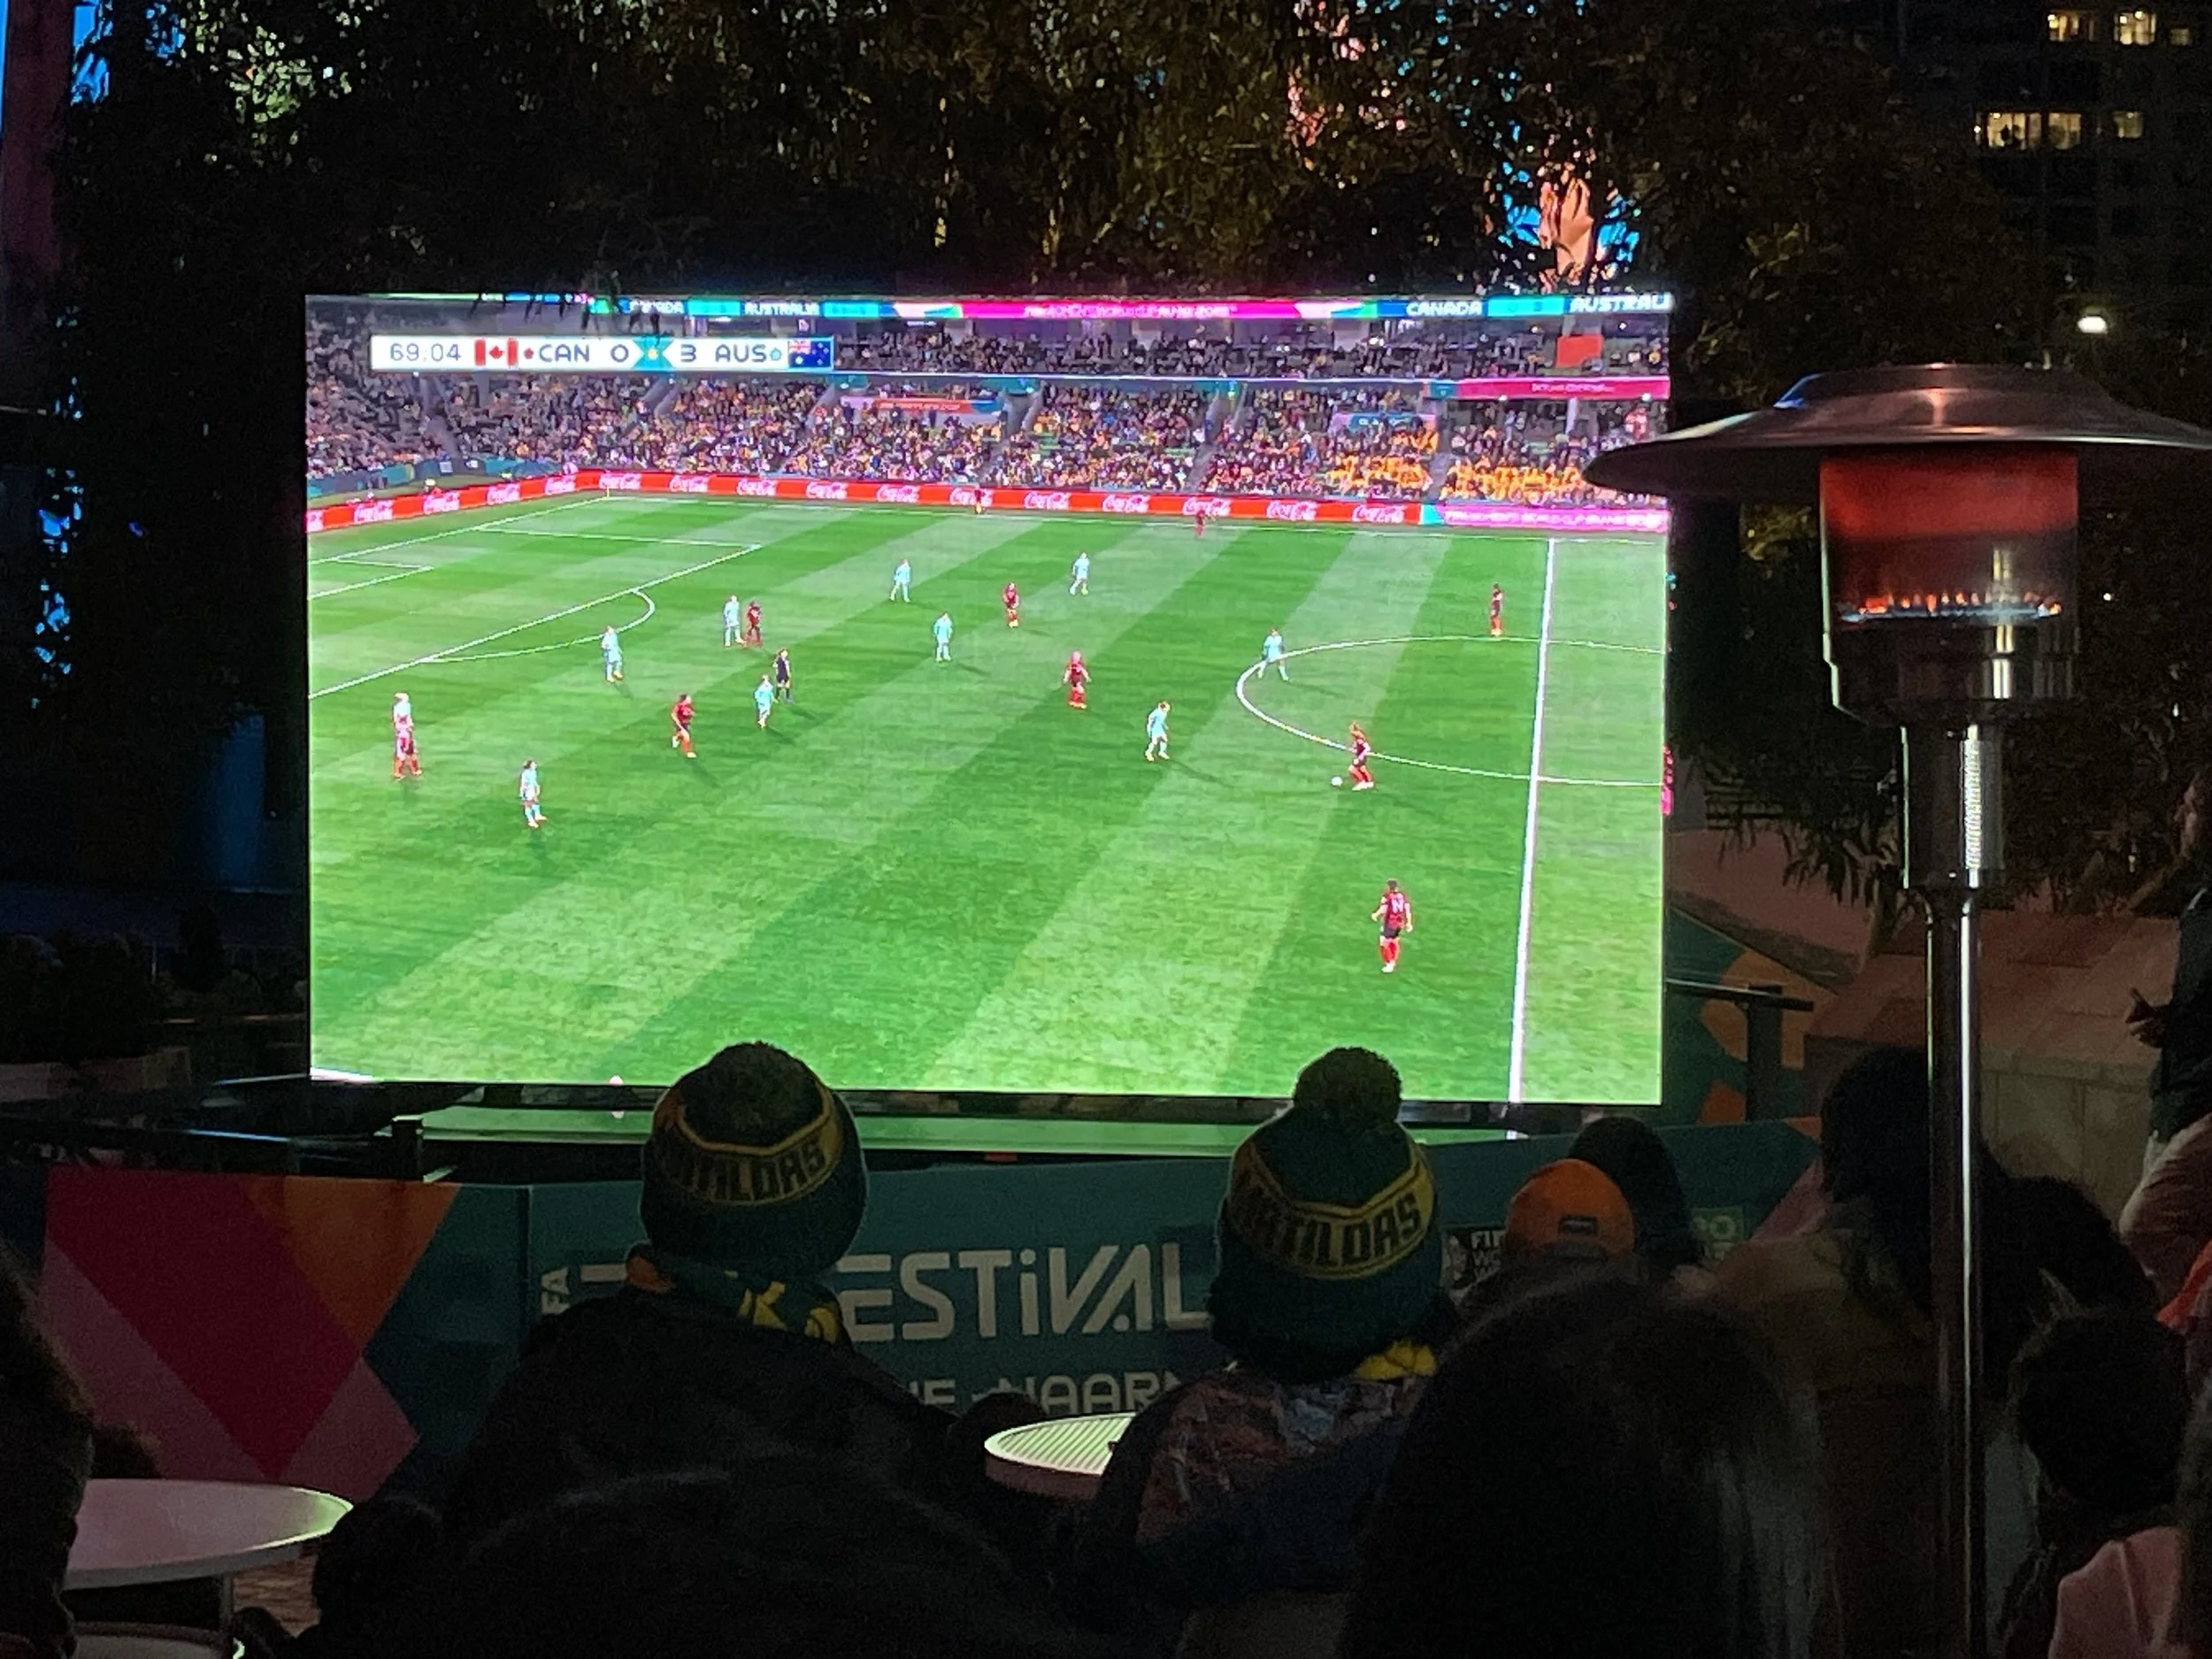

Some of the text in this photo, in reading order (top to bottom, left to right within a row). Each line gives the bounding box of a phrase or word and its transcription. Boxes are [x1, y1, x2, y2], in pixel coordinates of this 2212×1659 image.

[1406, 300, 1483, 317] CANADA
[390, 342, 462, 363] 69:04
[538, 343, 590, 363] CAN
[680, 344, 697, 363] 3
[715, 344, 767, 363] AUS
